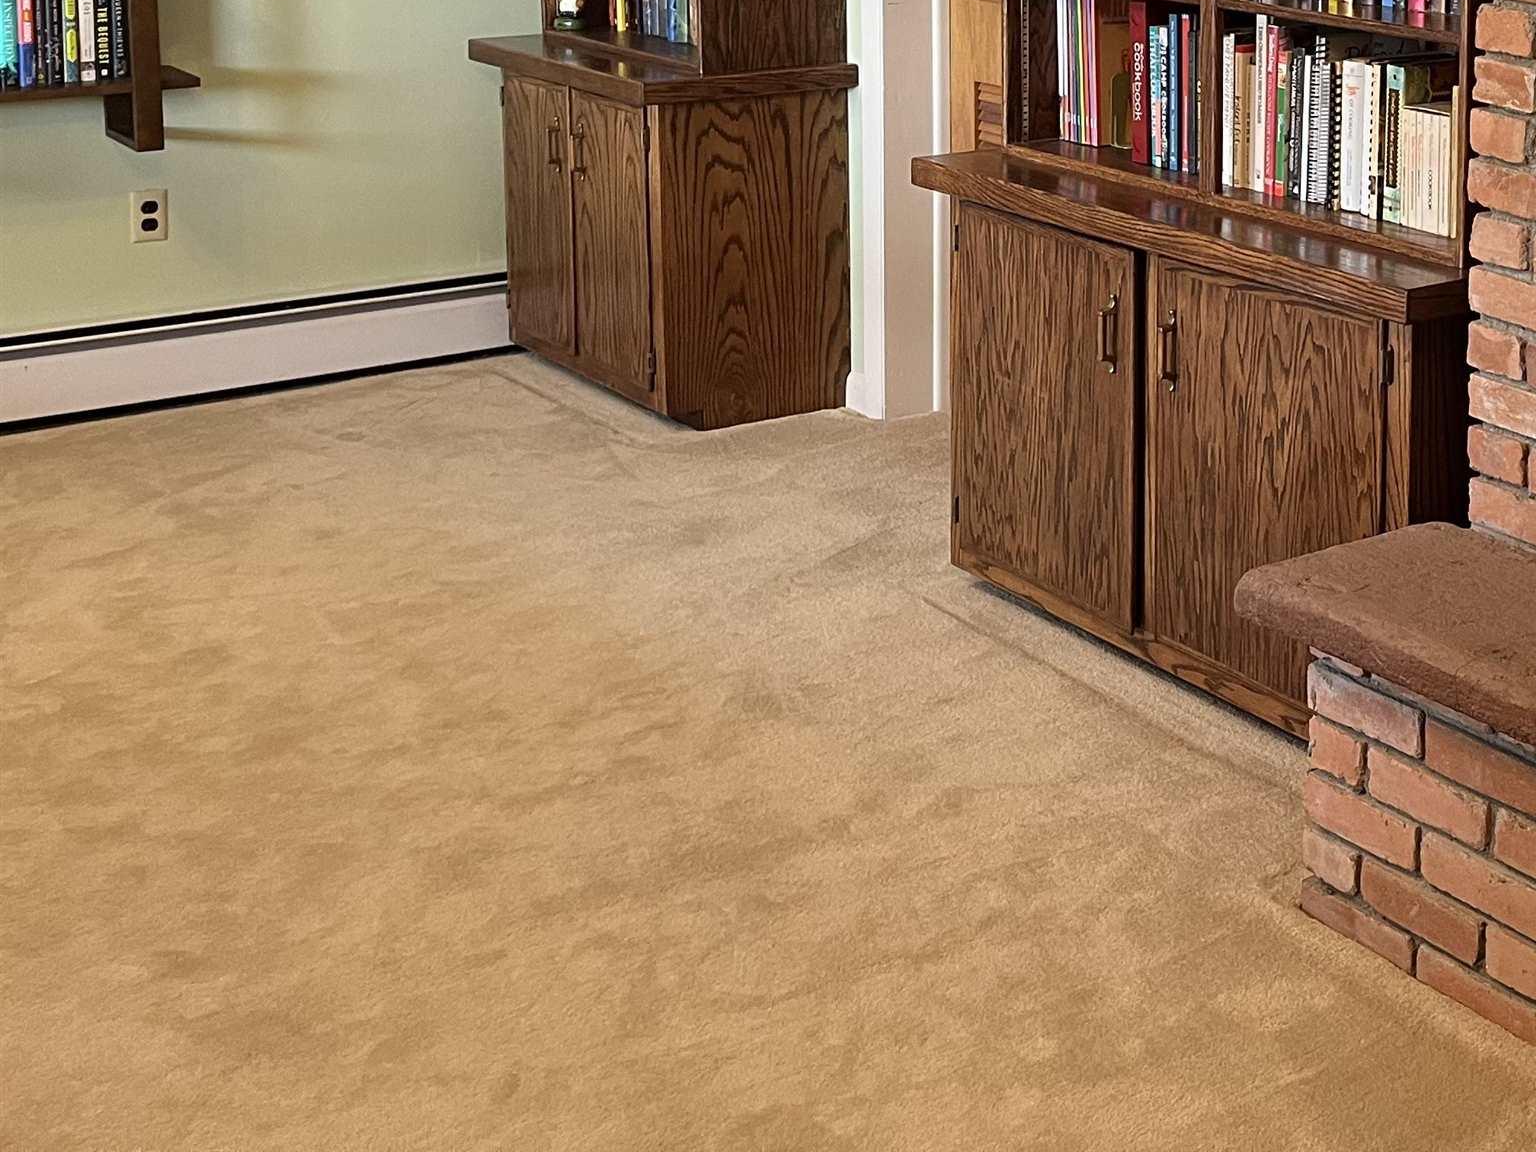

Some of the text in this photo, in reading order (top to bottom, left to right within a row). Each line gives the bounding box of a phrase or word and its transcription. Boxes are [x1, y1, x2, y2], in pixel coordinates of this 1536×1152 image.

[97, 8, 110, 64] THE BEQUEST
[1133, 42, 1142, 120] cookbook
